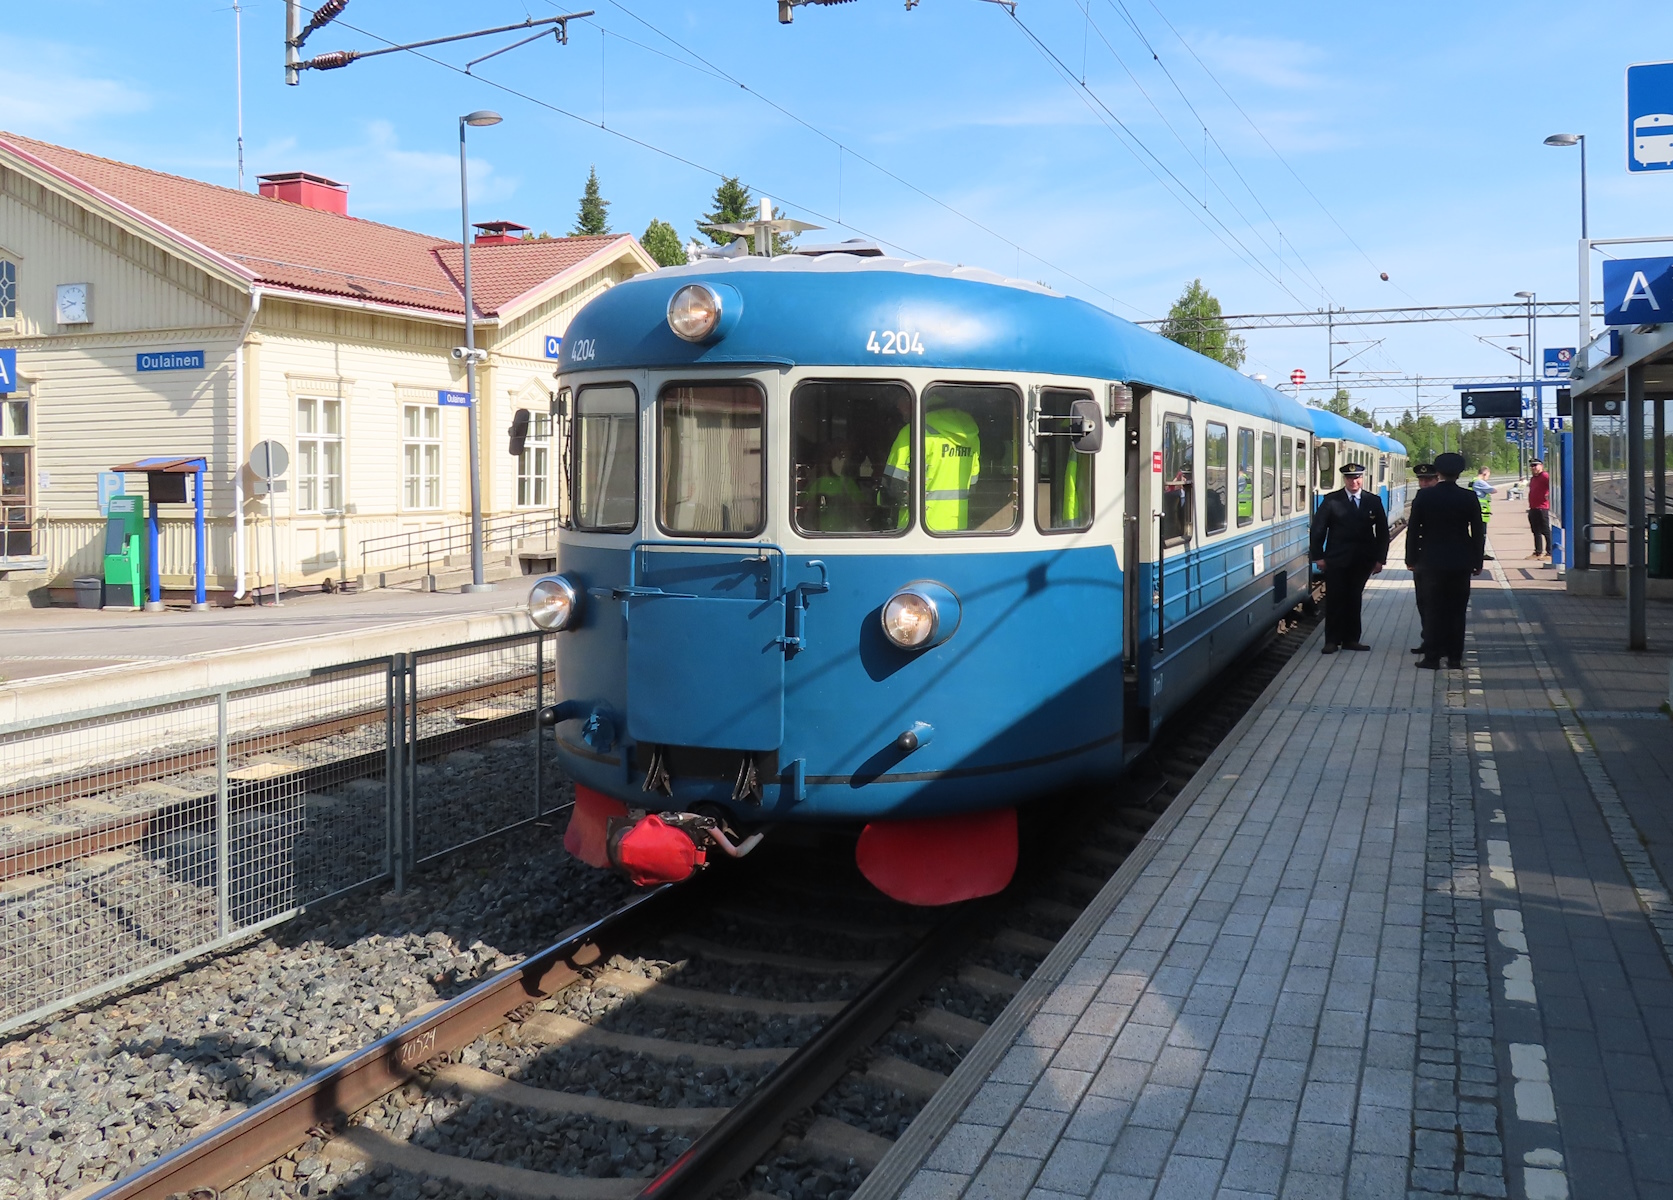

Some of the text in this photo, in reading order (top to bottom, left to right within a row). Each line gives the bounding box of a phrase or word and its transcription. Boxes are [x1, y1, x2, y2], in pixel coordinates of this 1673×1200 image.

[1620, 271, 1660, 312] A
[571, 339, 596, 361] 4204
[866, 330, 925, 355] 4204
[142, 354, 199, 369] Oulainen
[446, 393, 466, 404] Oulainen
[1507, 419, 1516, 429] 2
[1526, 419, 1534, 429] 3
[104, 474, 121, 503] P
